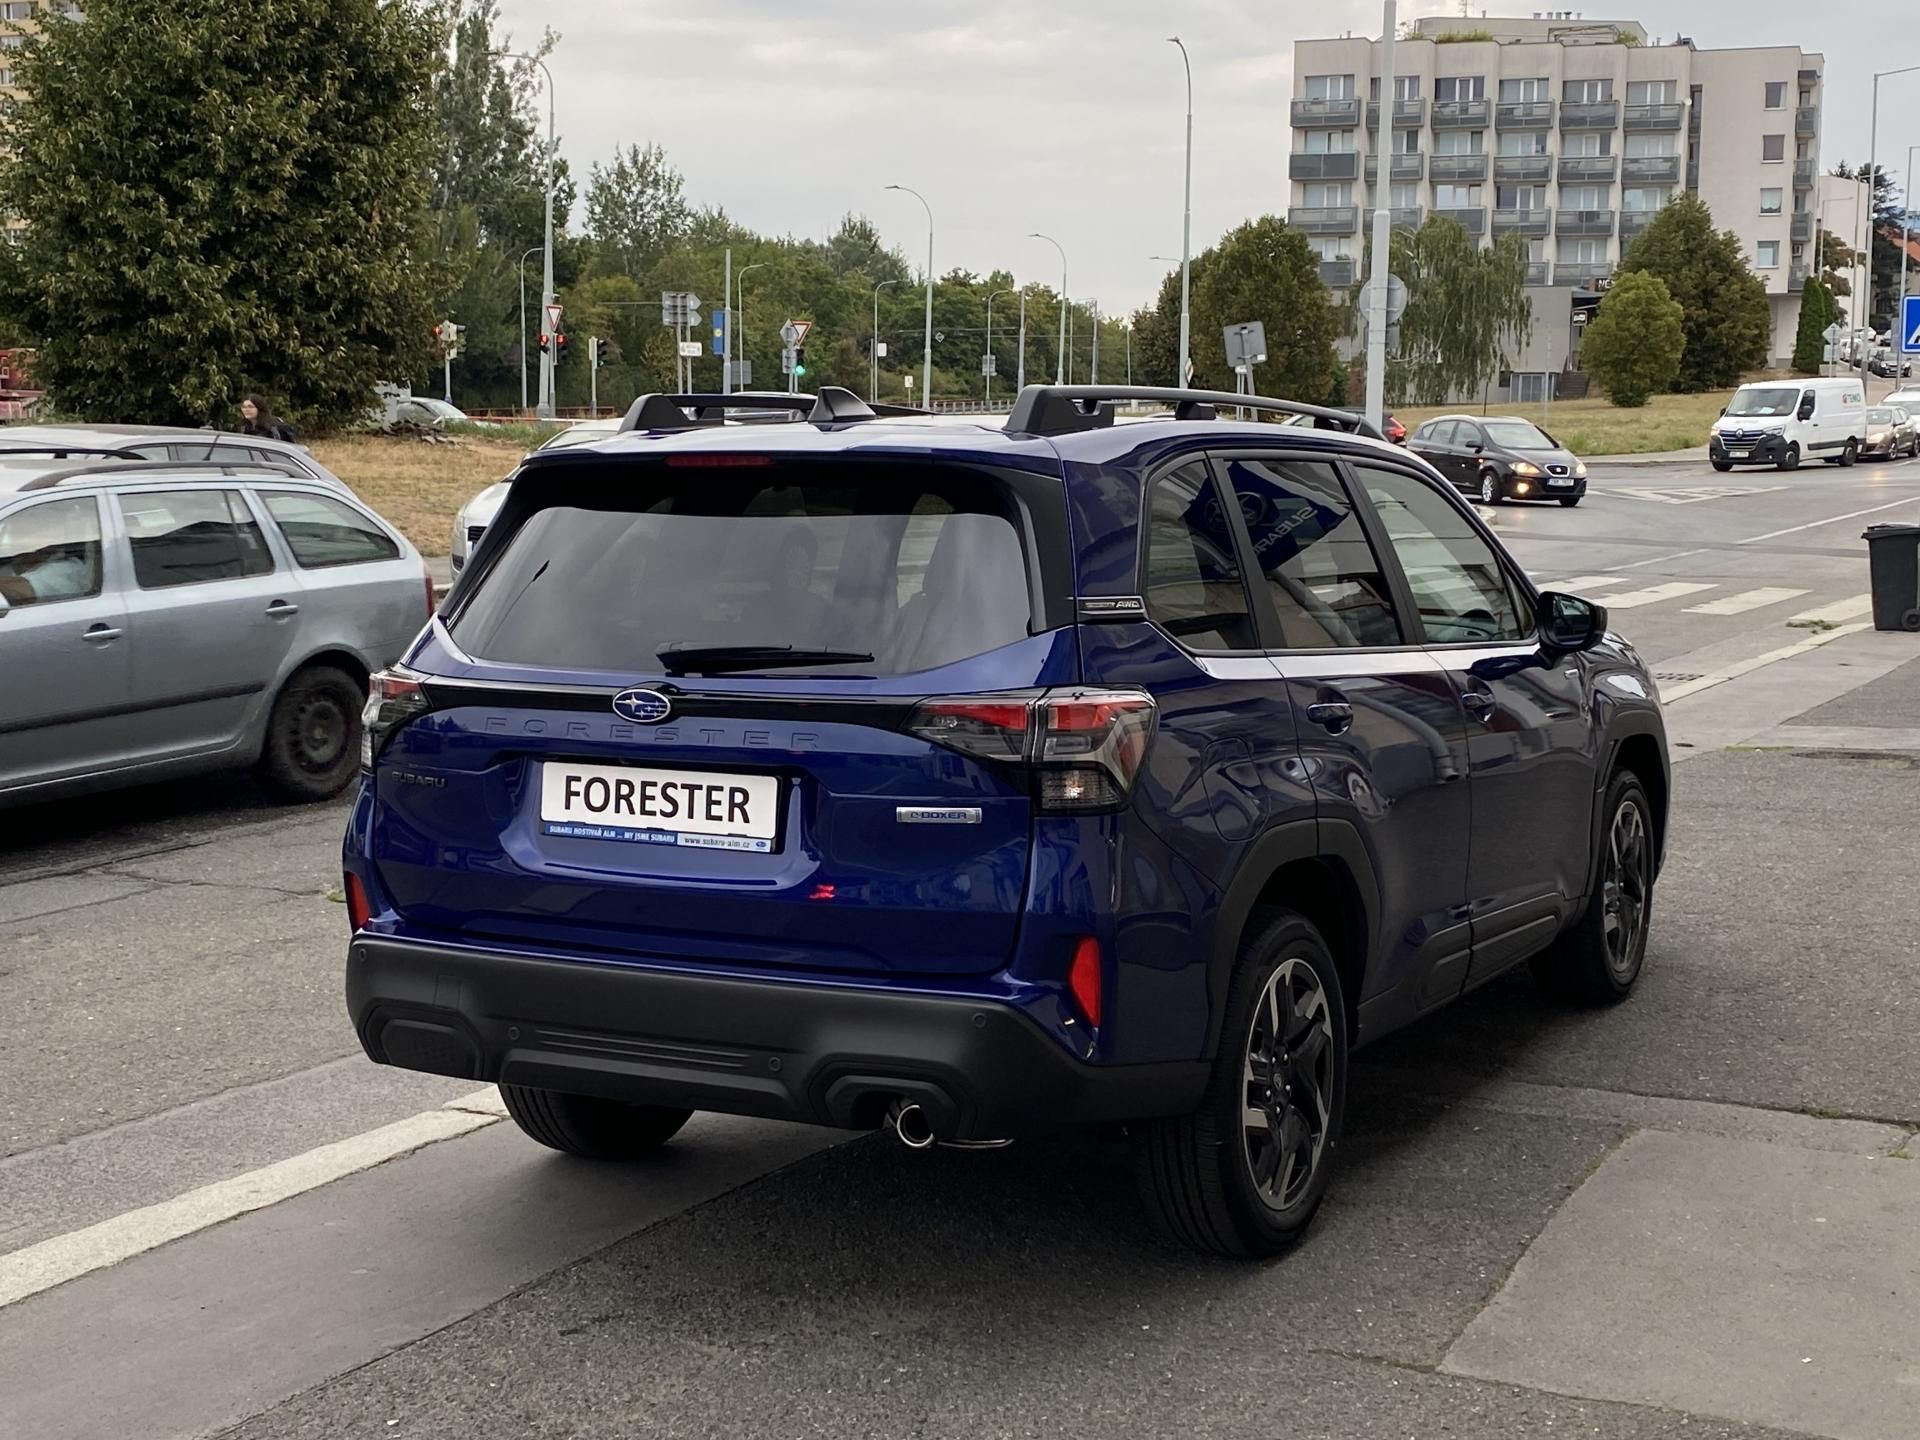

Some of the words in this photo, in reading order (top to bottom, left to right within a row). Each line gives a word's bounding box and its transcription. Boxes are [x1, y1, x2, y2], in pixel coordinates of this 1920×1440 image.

[484, 716, 820, 750] FORESTER
[391, 770, 446, 788] SUBARU
[564, 775, 751, 824] FORESTER
[549, 825, 573, 834] SUBARU
[624, 831, 634, 840] MY
[651, 834, 675, 843] SUBARU
